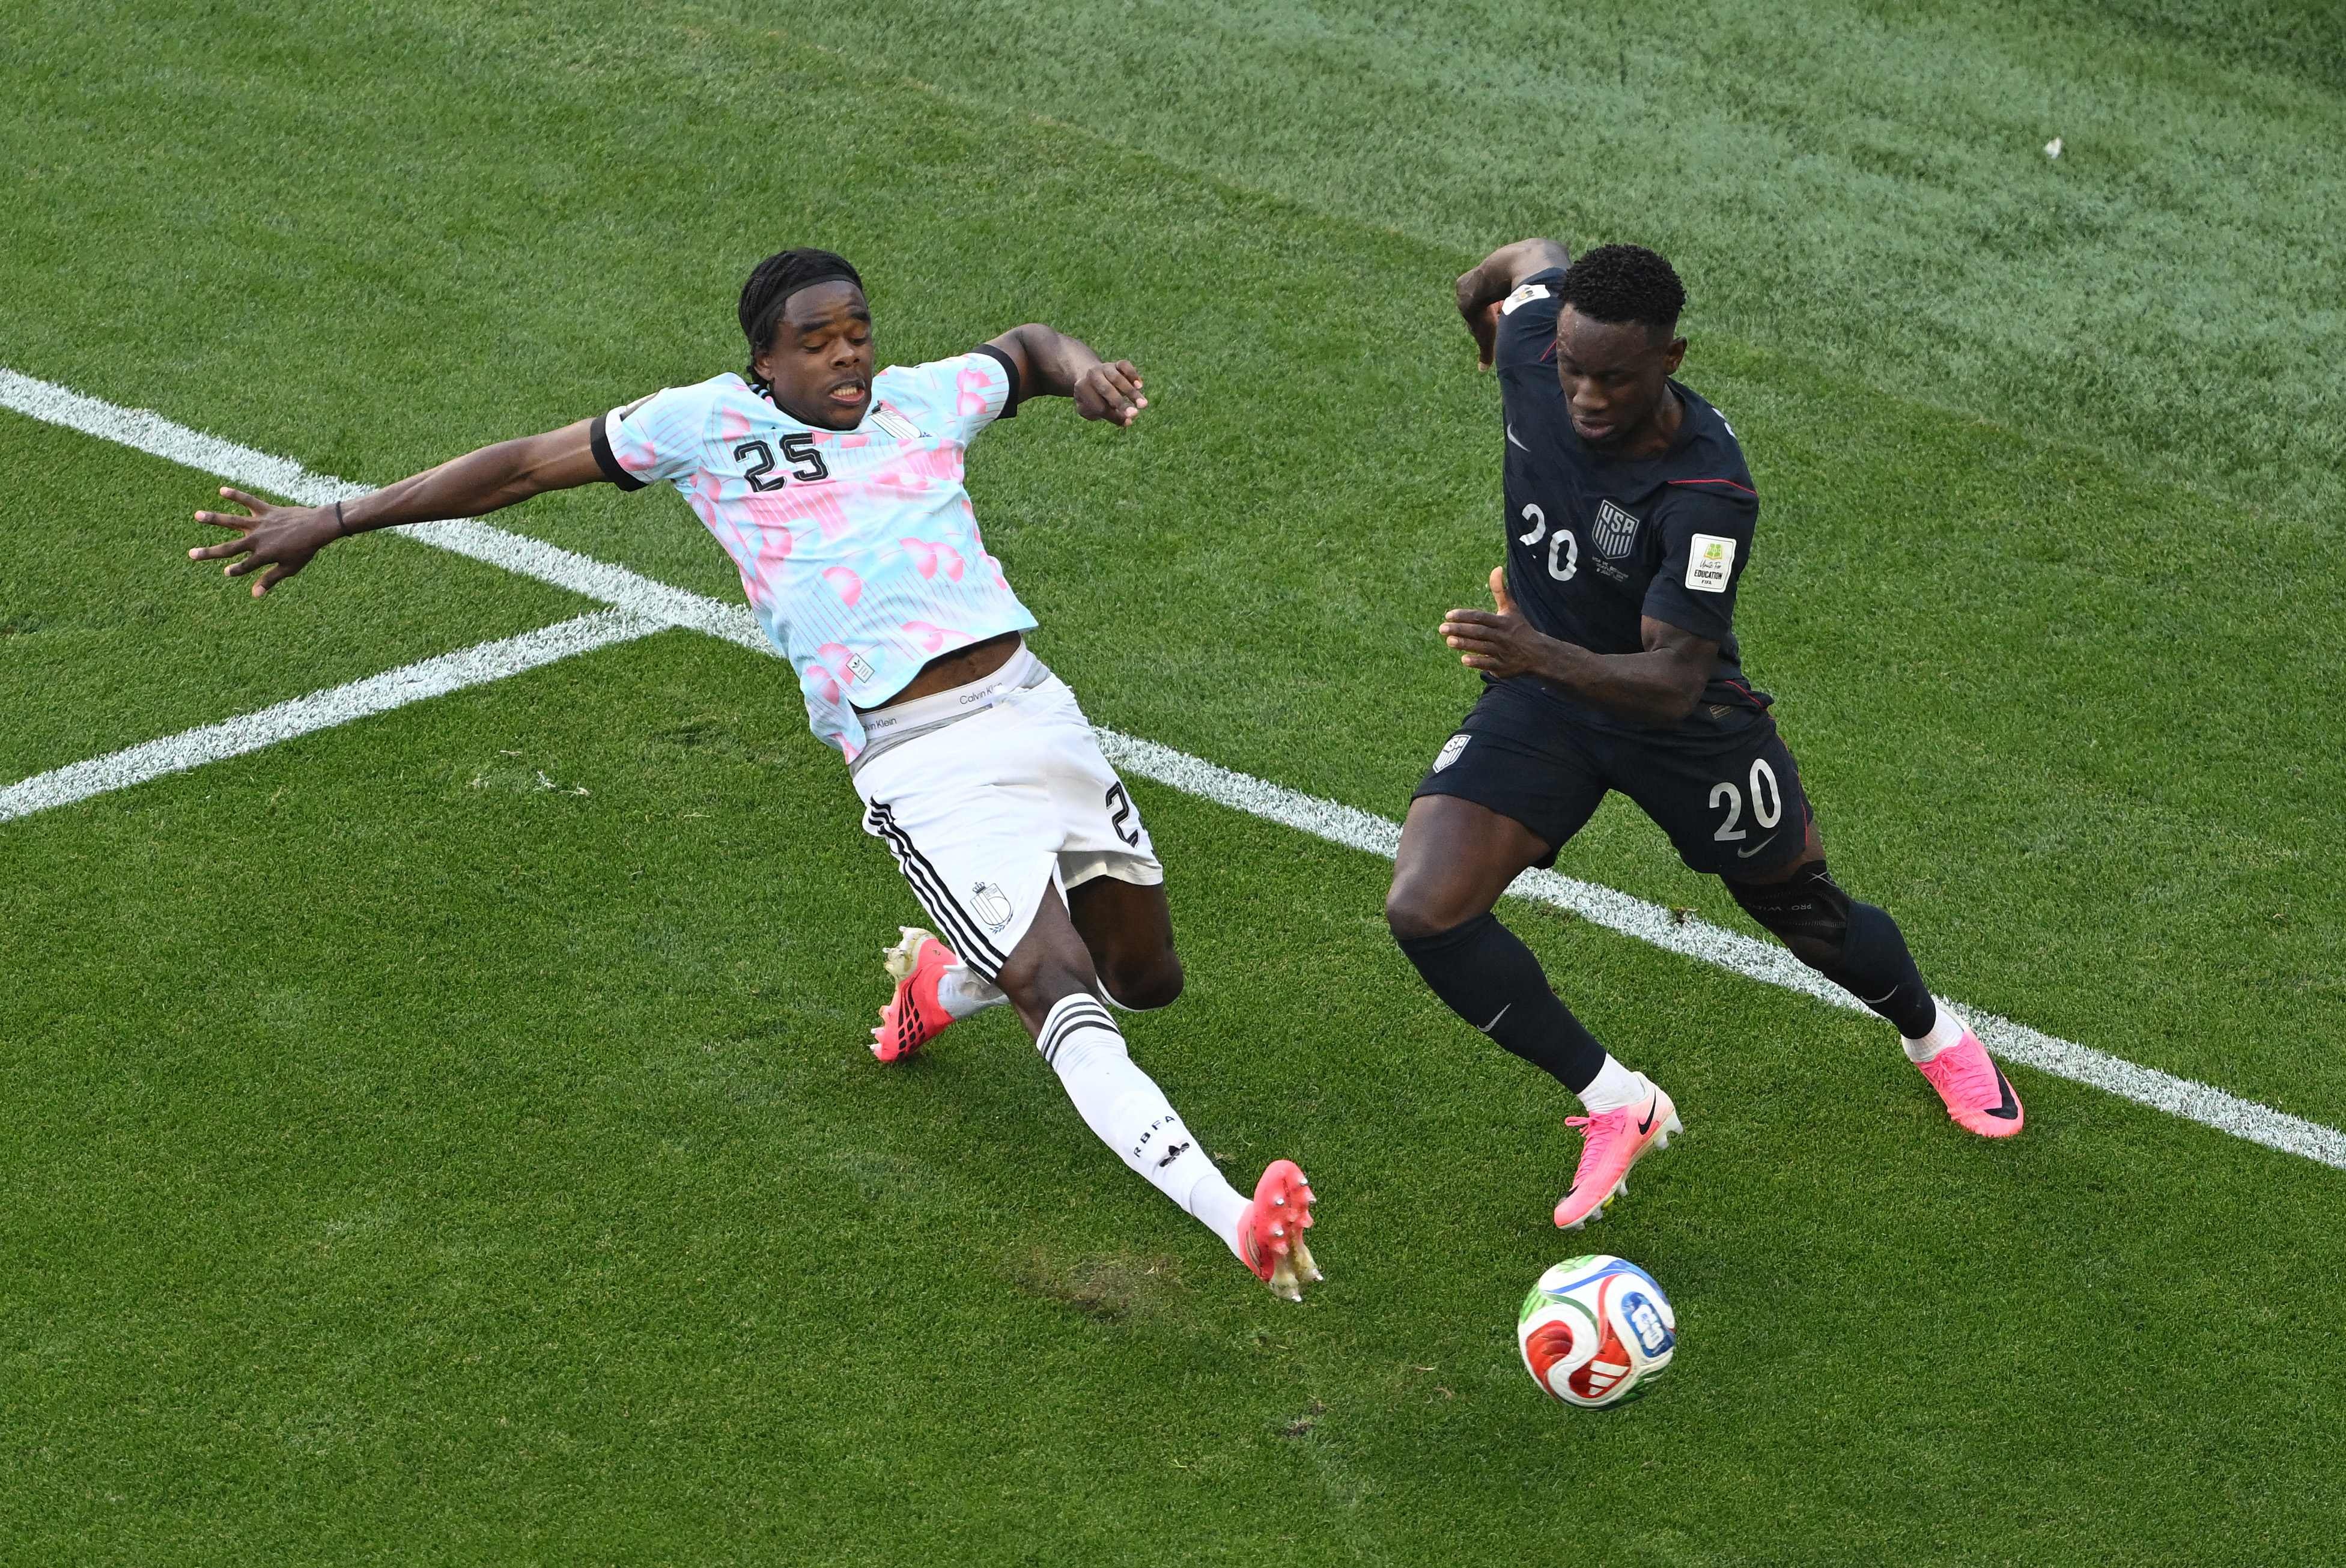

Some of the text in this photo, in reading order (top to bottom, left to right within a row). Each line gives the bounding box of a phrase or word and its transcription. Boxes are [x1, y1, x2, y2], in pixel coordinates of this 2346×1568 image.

[733, 432, 830, 492] 25
[1602, 504, 1635, 534] USA
[1519, 503, 1578, 581] 20
[1694, 569, 1723, 580] EDUCATION
[959, 690, 986, 705] Calvin
[875, 718, 897, 728] Klein
[1105, 780, 1145, 849] 2
[1709, 758, 1781, 841] 20
[1133, 1116, 1175, 1158] RBFA
